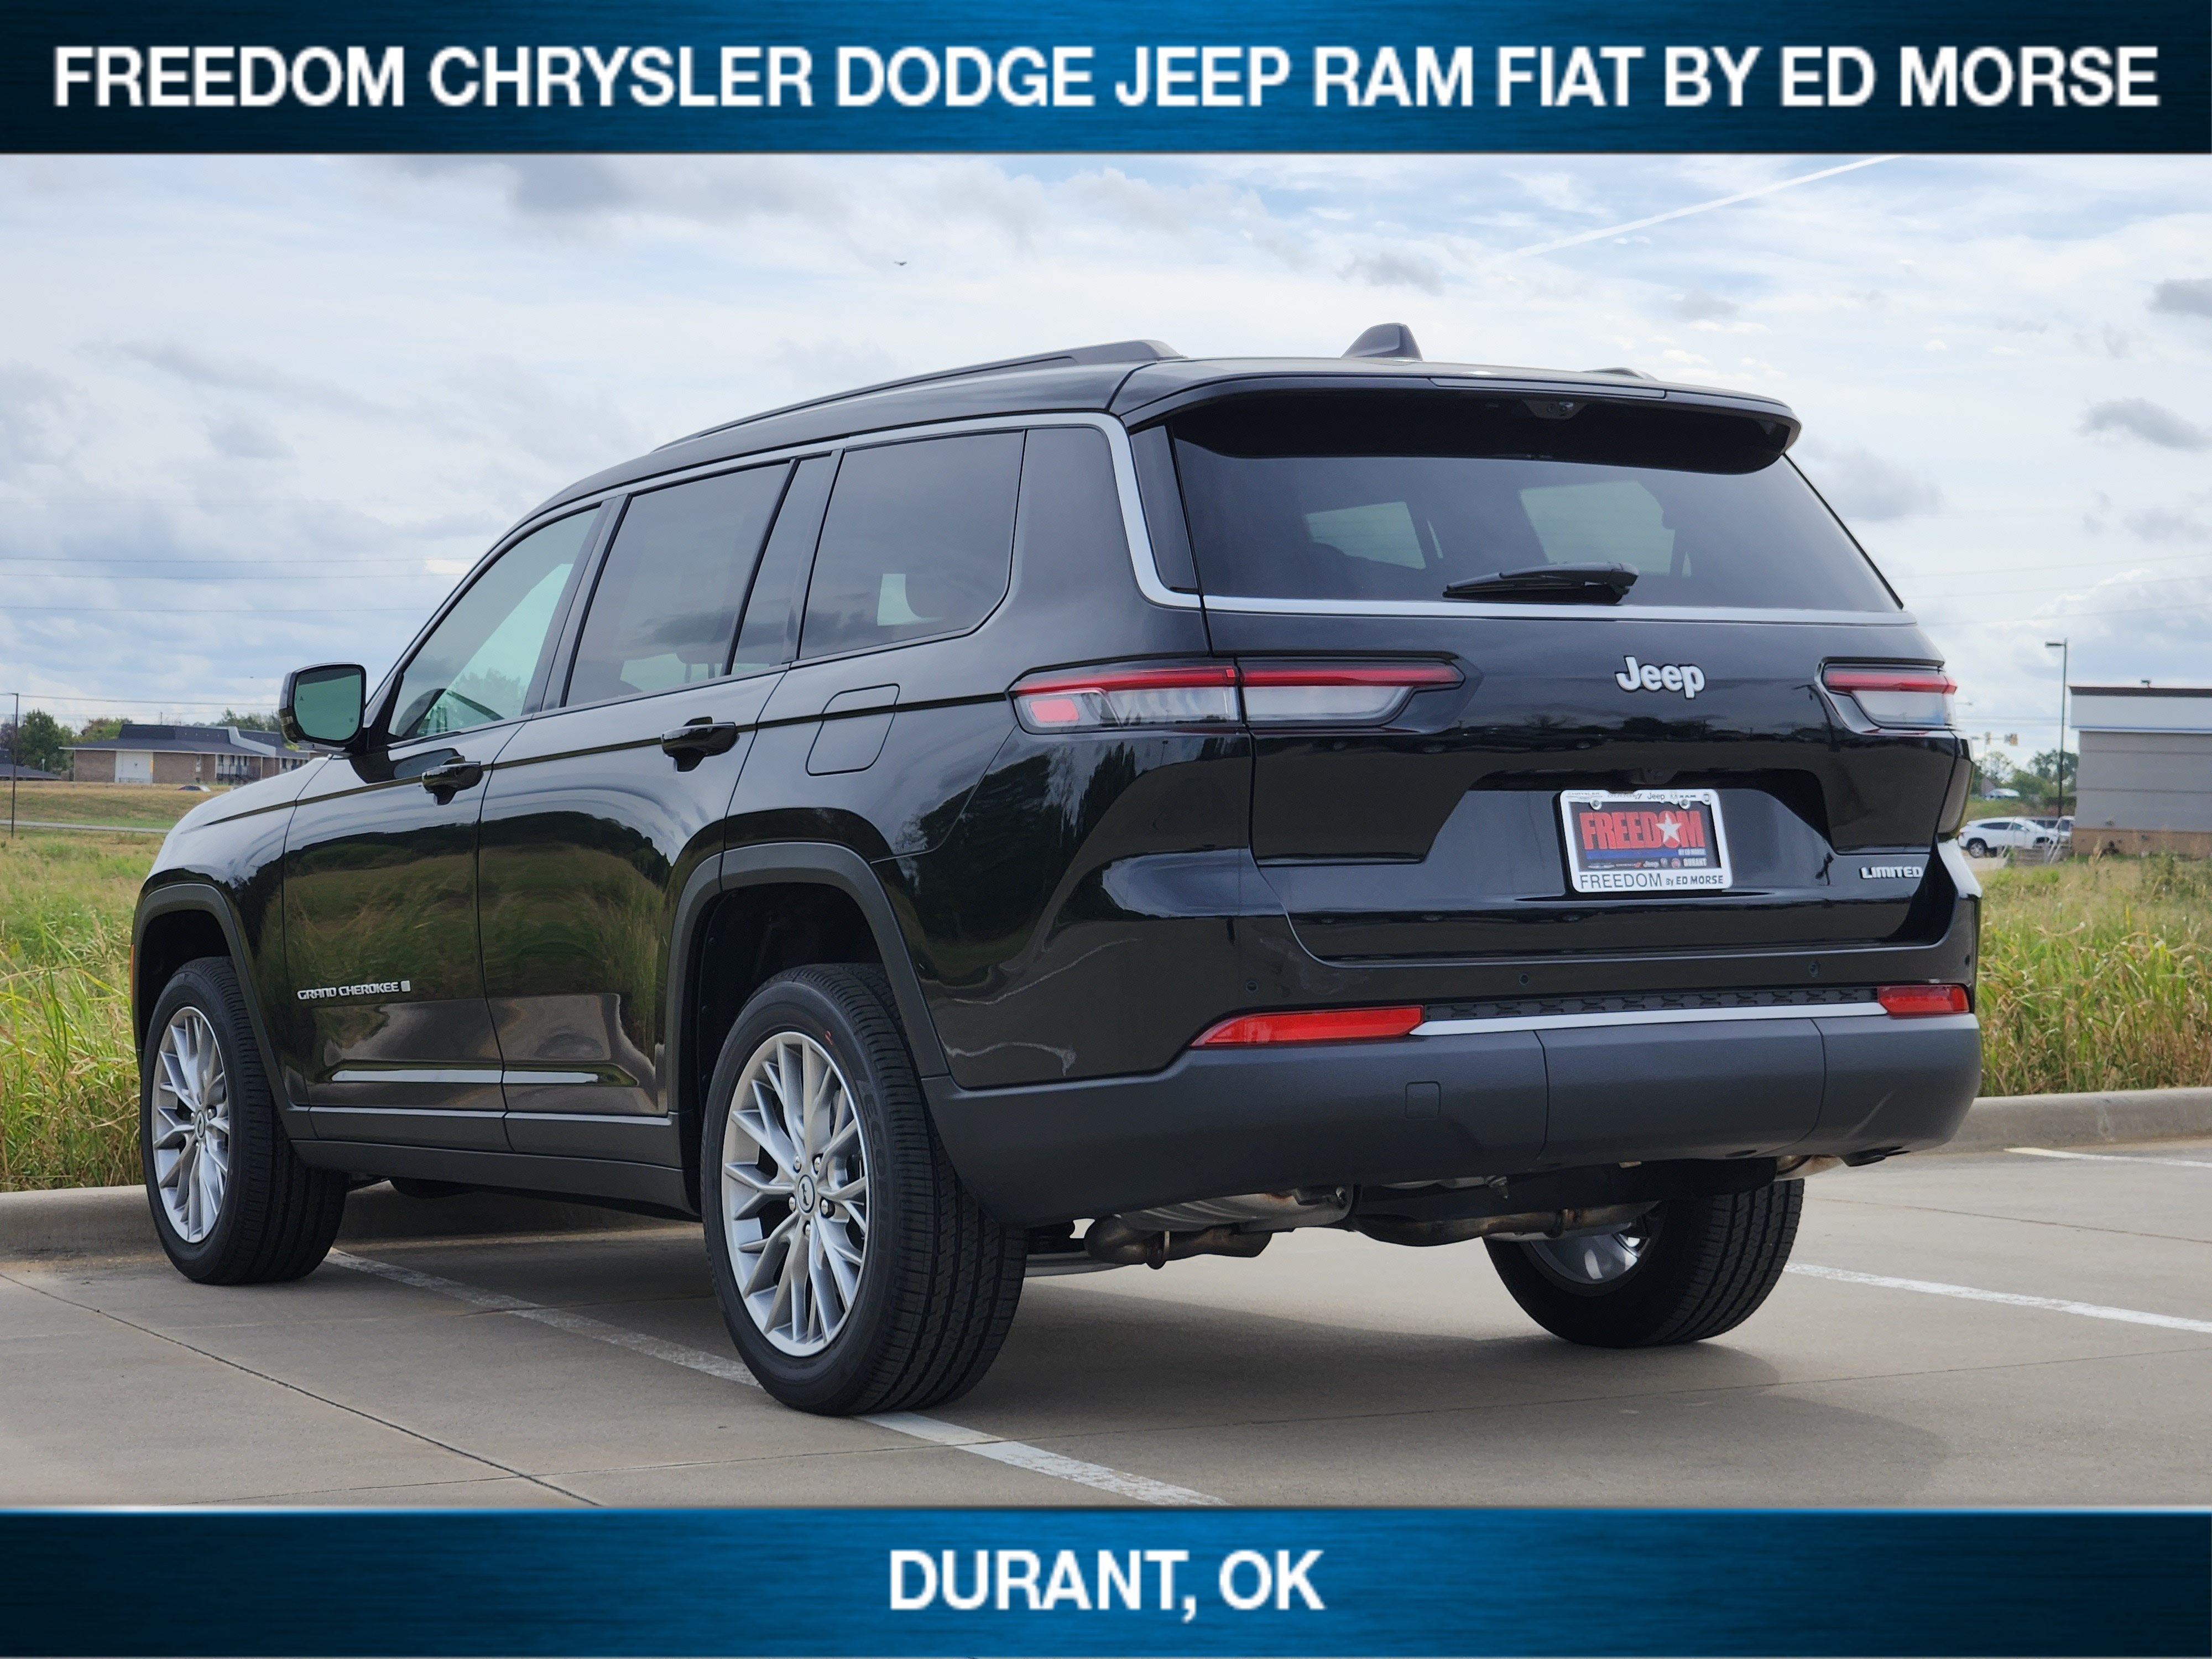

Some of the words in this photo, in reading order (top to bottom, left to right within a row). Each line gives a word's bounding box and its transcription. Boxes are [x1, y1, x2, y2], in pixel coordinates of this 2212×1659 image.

[1614, 655, 1705, 699] Jeep
[1579, 811, 1706, 850] FREEDOM
[1579, 873, 1662, 889] FREEDOM
[1676, 876, 1687, 885] ED
[1690, 875, 1724, 885] MORSE
[1860, 866, 1923, 879] LIMITED
[297, 987, 337, 1000] GRAND
[338, 982, 399, 996] CHEROKEE
